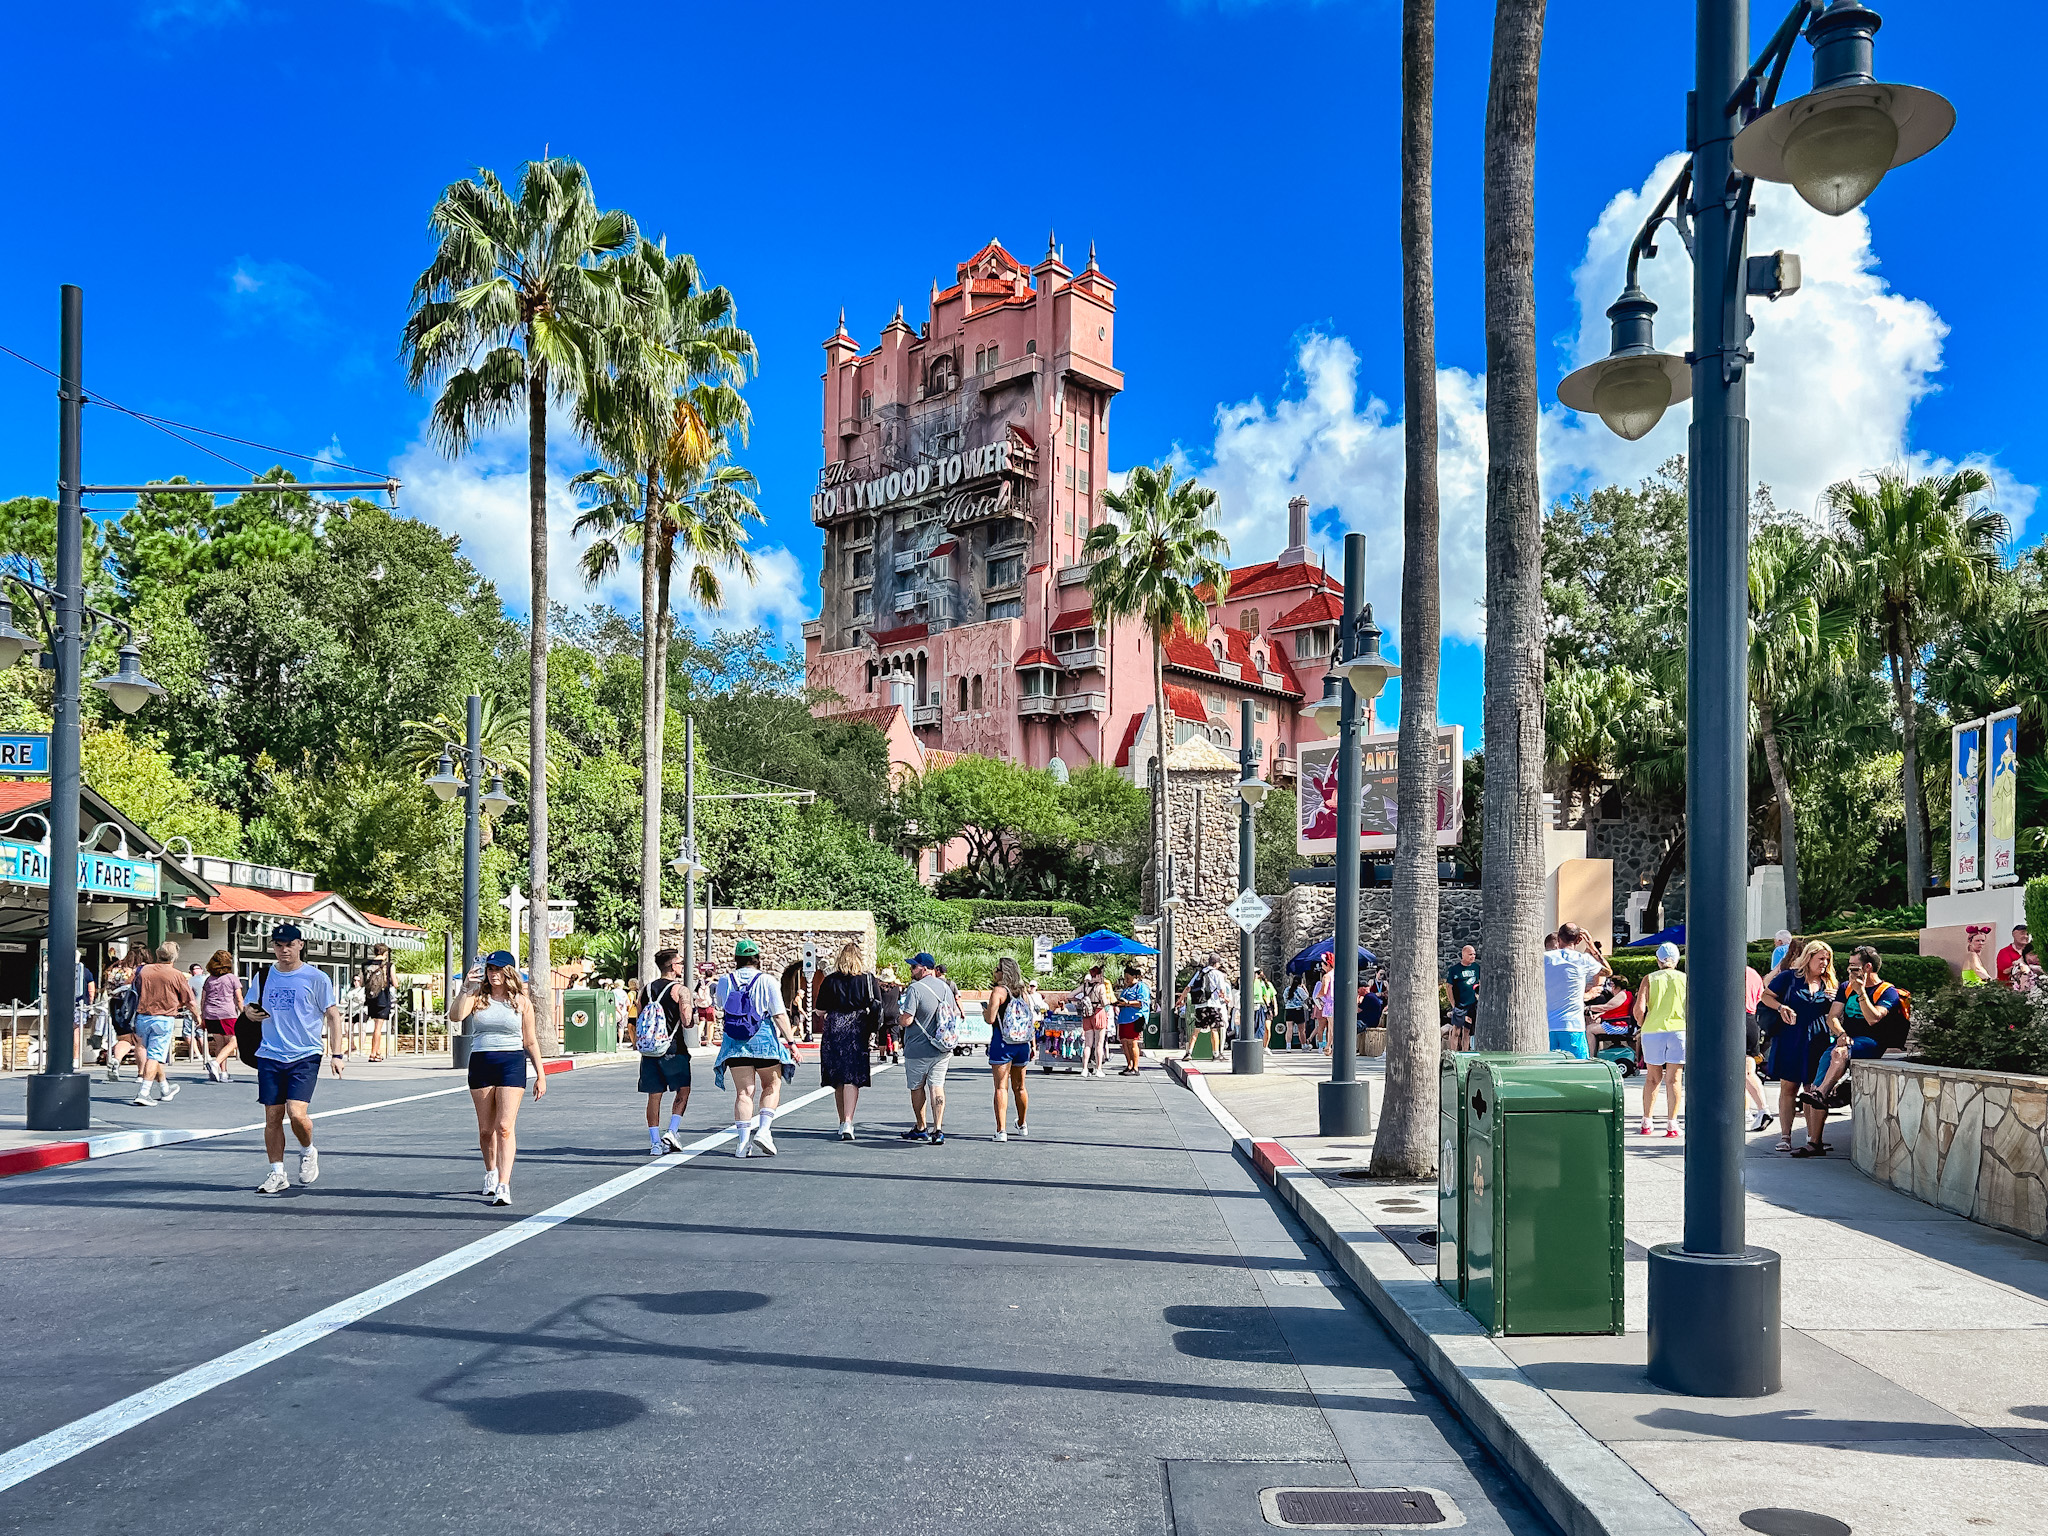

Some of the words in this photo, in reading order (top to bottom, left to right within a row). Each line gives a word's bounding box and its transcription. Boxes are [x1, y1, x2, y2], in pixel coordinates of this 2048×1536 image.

[811, 464, 931, 522] HOLLYWOOD
[937, 441, 1012, 486] TOWER
[823, 459, 856, 488] The
[940, 480, 1011, 527] Hotel
[94, 860, 131, 888] FARE
[235, 863, 252, 883] ICE
[254, 868, 290, 890] CREAM
